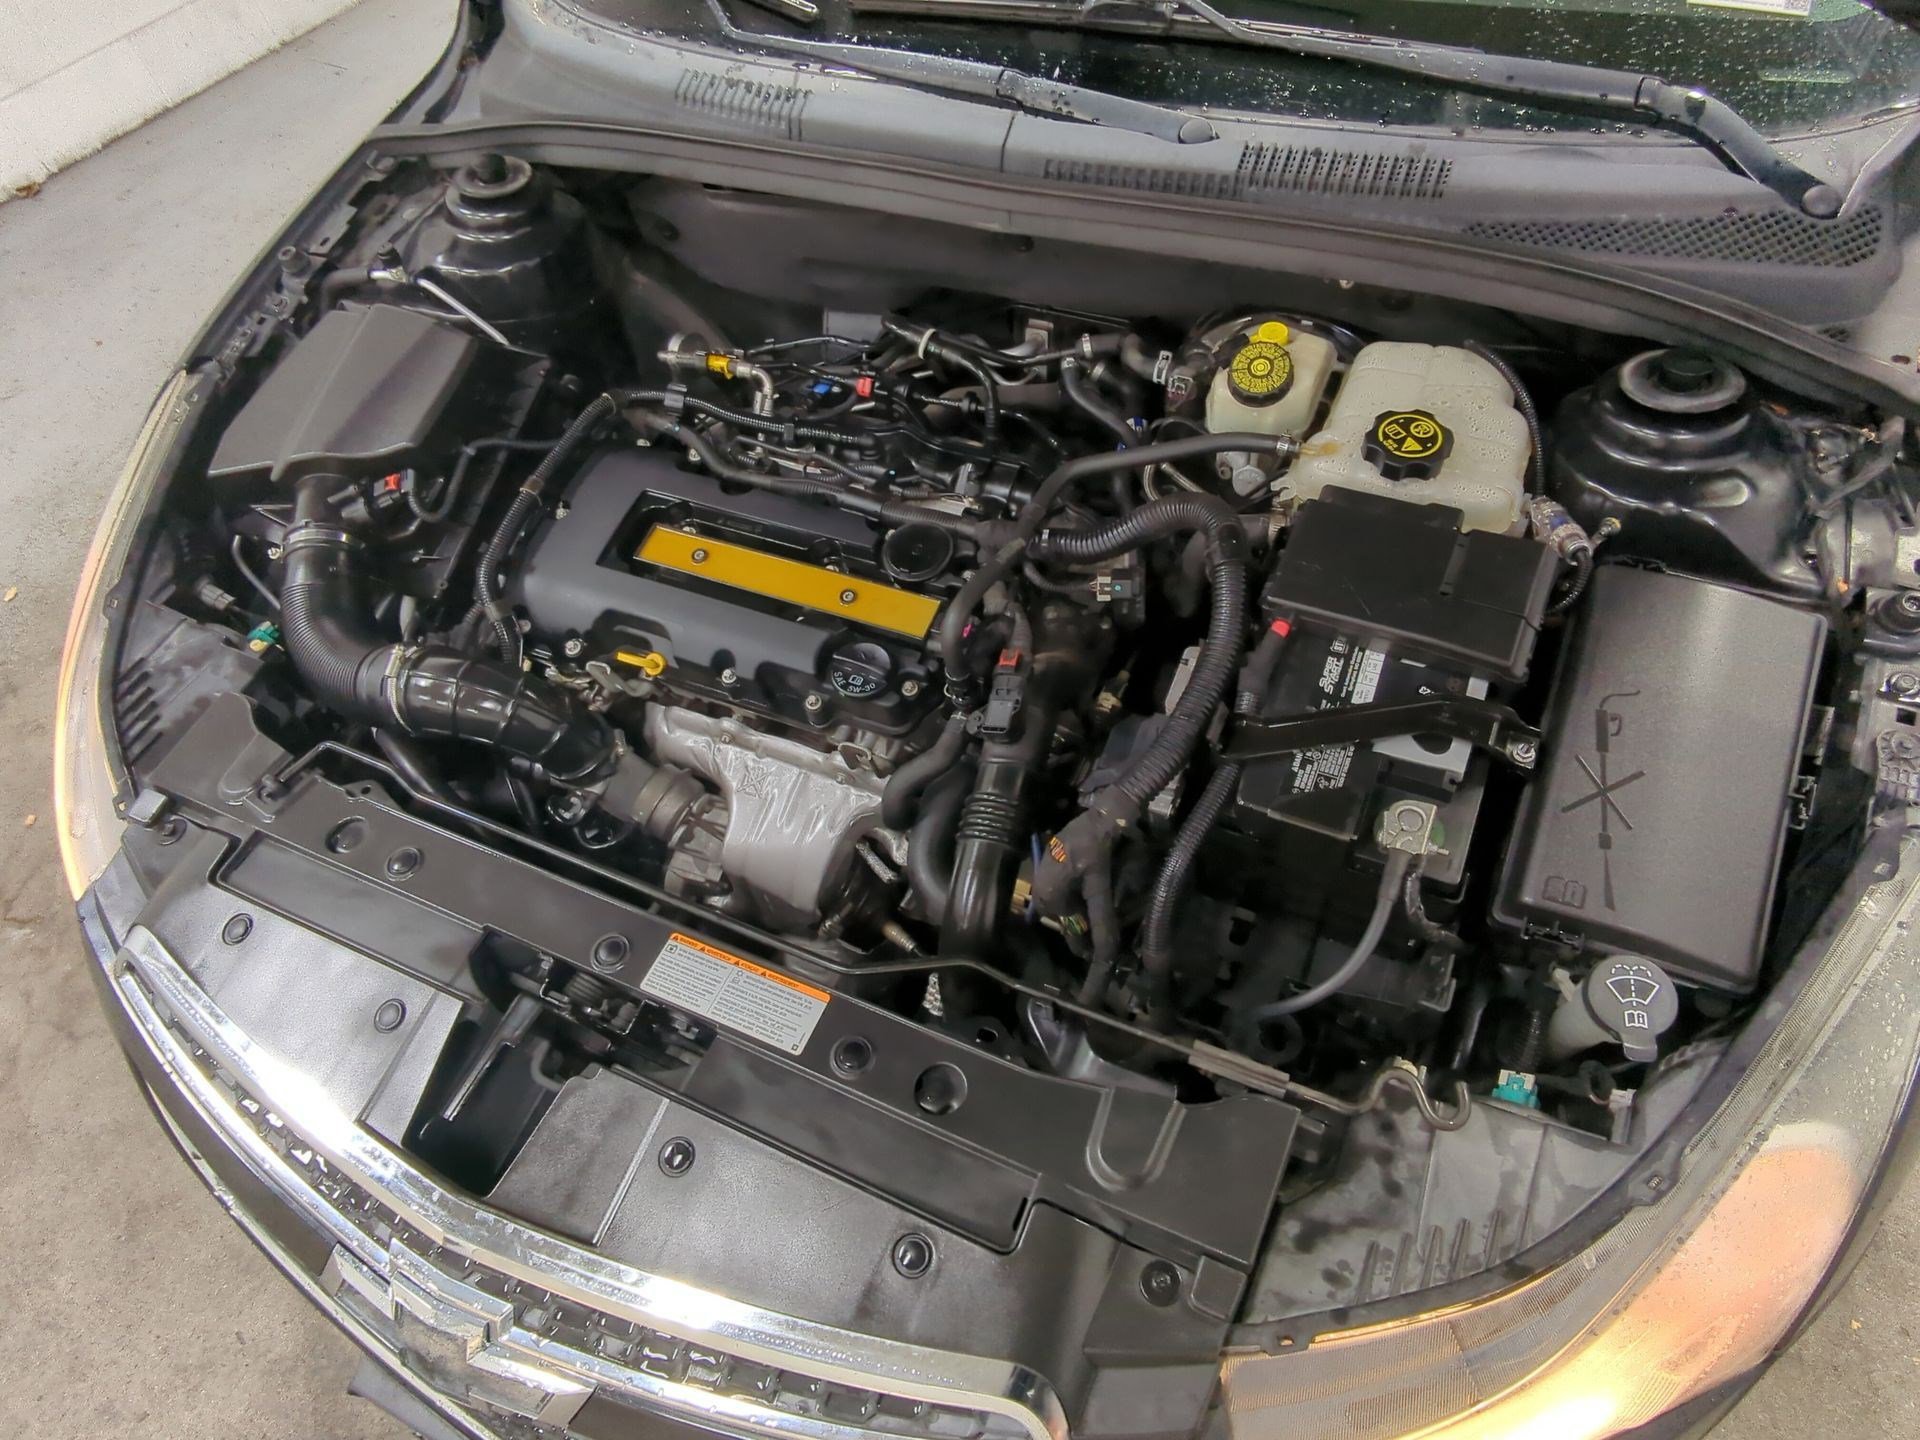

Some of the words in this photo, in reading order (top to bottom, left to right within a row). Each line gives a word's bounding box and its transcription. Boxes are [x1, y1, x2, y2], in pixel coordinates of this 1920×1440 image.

[833, 671, 847, 687] SAE
[847, 682, 876, 693] 5W-30
[1319, 656, 1334, 688] SUPER
[1324, 657, 1339, 695] START
